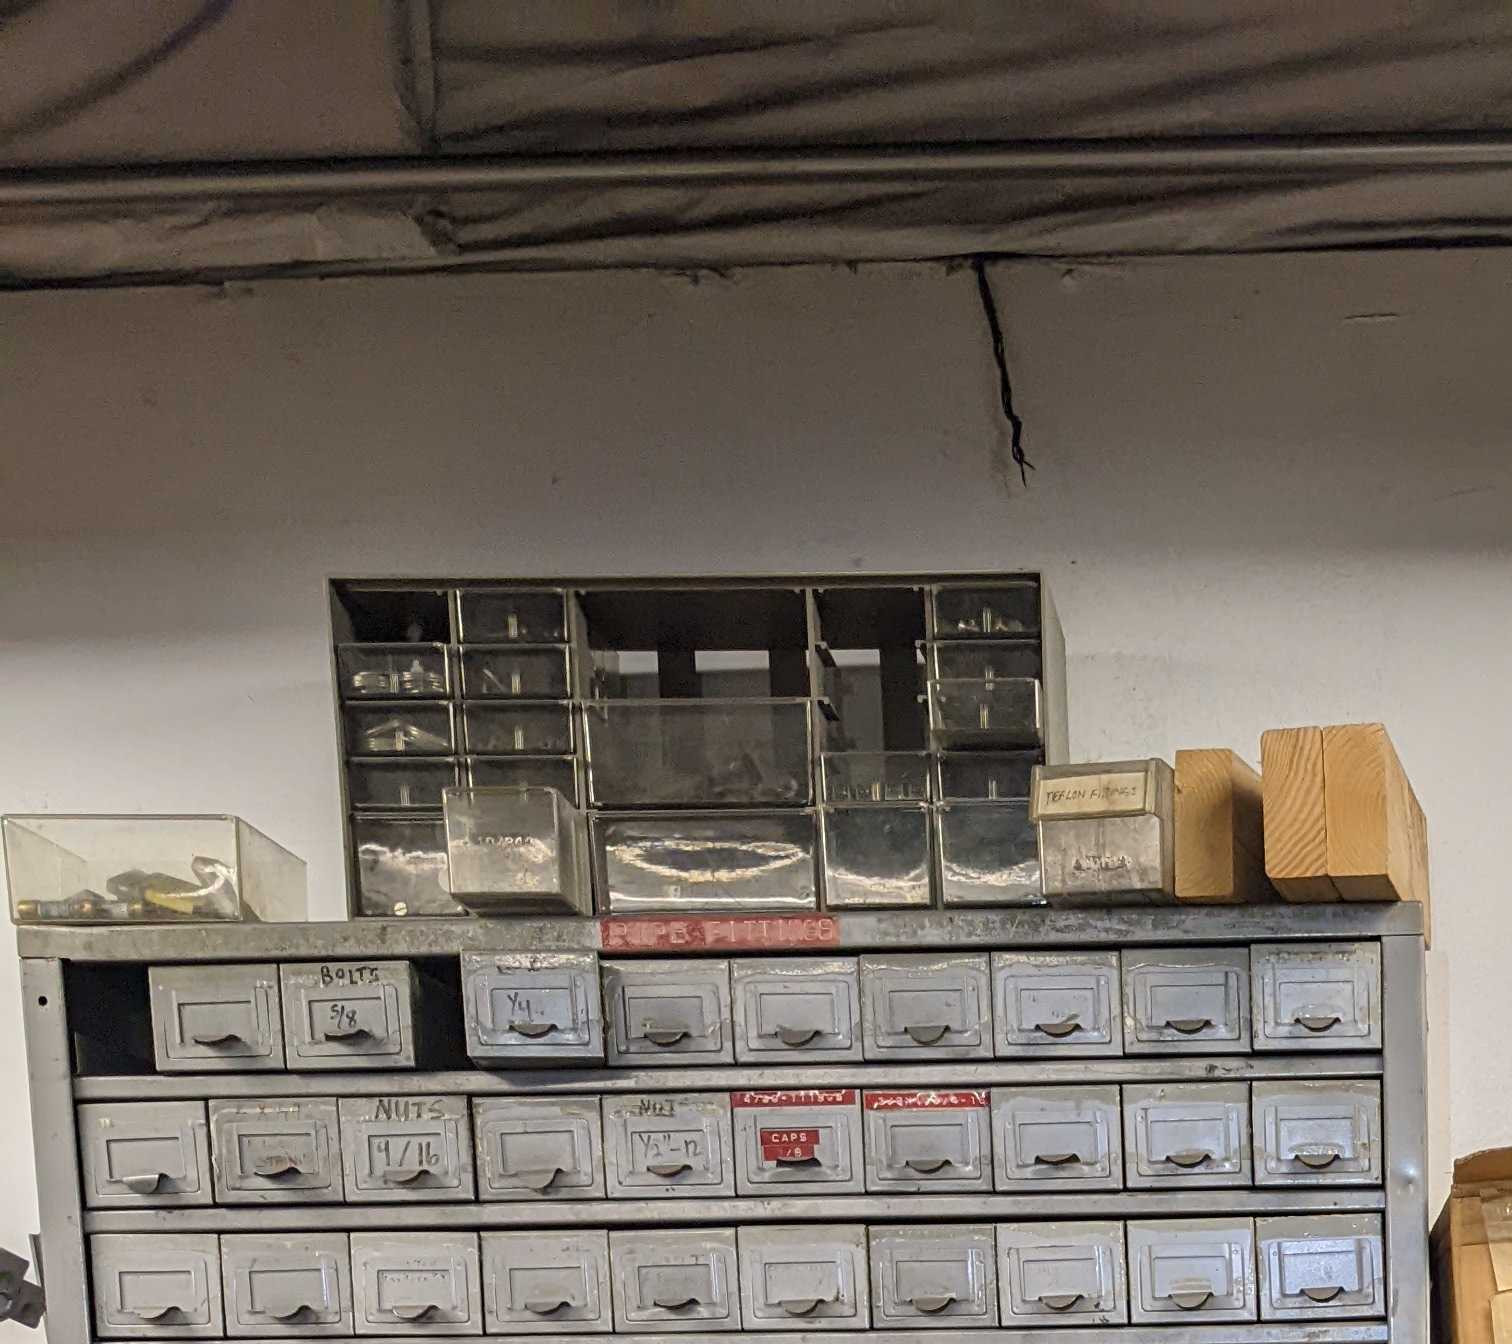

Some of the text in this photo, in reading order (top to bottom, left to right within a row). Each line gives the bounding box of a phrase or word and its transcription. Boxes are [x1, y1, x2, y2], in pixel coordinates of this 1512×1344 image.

[320, 965, 380, 986] BOLTS
[374, 1099, 446, 1121] NUTS
[771, 1131, 809, 1145] CAPS
